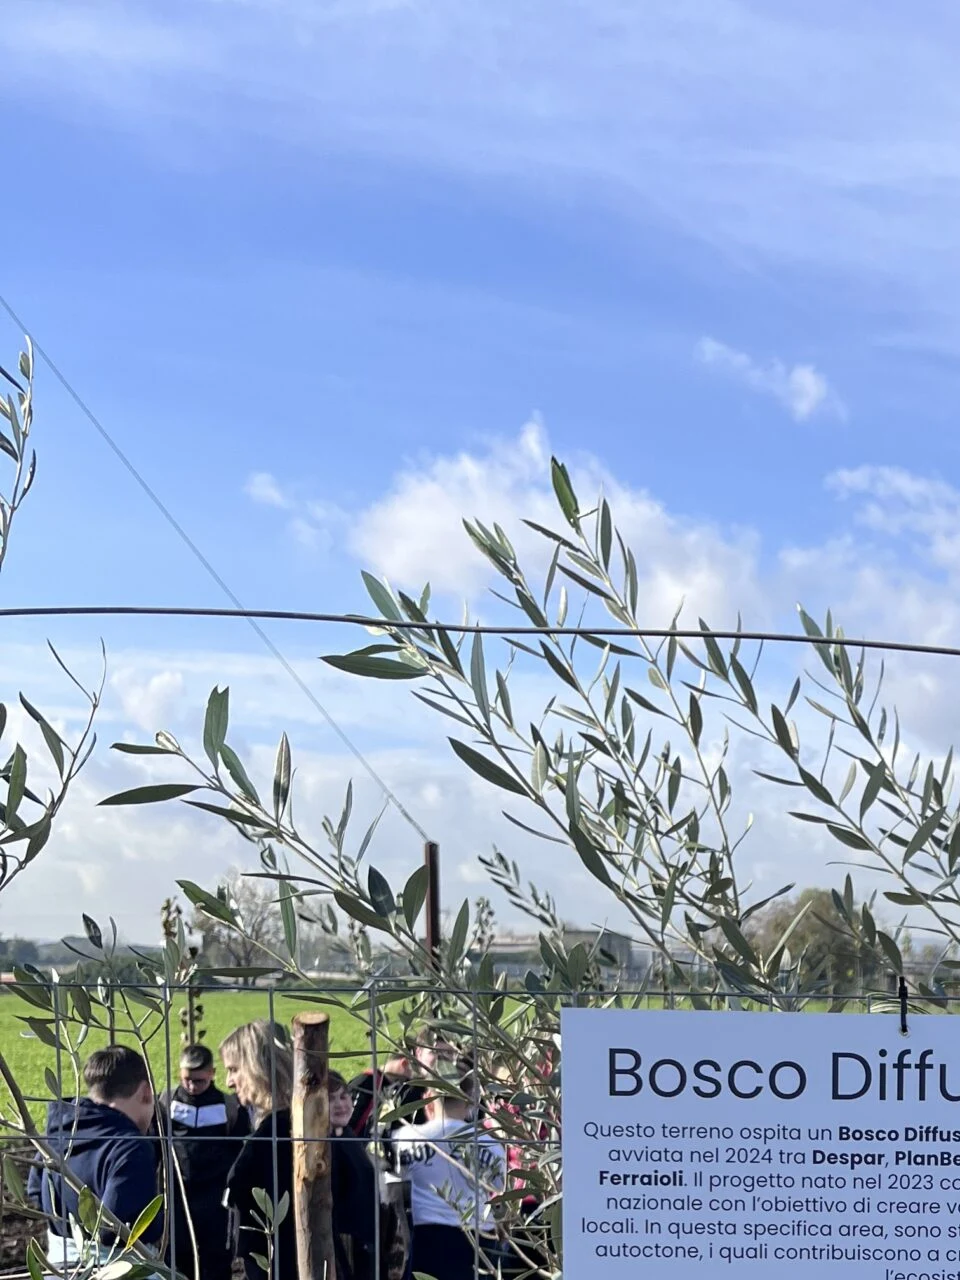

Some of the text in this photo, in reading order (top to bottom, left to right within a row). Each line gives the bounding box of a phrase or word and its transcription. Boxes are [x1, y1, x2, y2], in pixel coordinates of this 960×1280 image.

[608, 1047, 807, 1101] Bosco
[583, 1121, 656, 1141] Questo
[660, 1123, 734, 1140] terreno
[739, 1123, 802, 1146] ospita
[807, 1128, 833, 1142] un
[838, 1125, 900, 1142] Bosco
[607, 1145, 684, 1163] avviata
[689, 1147, 720, 1164] nel
[724, 1147, 774, 1165] 2024
[778, 1149, 806, 1165] tra
[812, 1149, 889, 1171] Despar,
[598, 1169, 688, 1187] Ferraioli.
[693, 1170, 703, 1188] Il
[709, 1172, 796, 1193] progetto
[801, 1173, 847, 1190] nato
[852, 1172, 882, 1190] nel
[887, 1173, 934, 1191] 2023
[606, 1193, 703, 1211] nazionale
[708, 1198, 746, 1212] con
[852, 1196, 871, 1214] di
[876, 1200, 941, 1215] creare
[581, 1216, 639, 1234] locali.
[644, 1218, 662, 1235] In
[667, 1220, 737, 1240] questa
[743, 1219, 833, 1241] specifica
[838, 1224, 889, 1241] area,
[894, 1224, 942, 1239] sono
[595, 1242, 704, 1262] autoctone,
[708, 1242, 713, 1259] i
[718, 1242, 768, 1264] quali
[773, 1243, 922, 1262] contribuiscono
[926, 1249, 940, 1262] a
